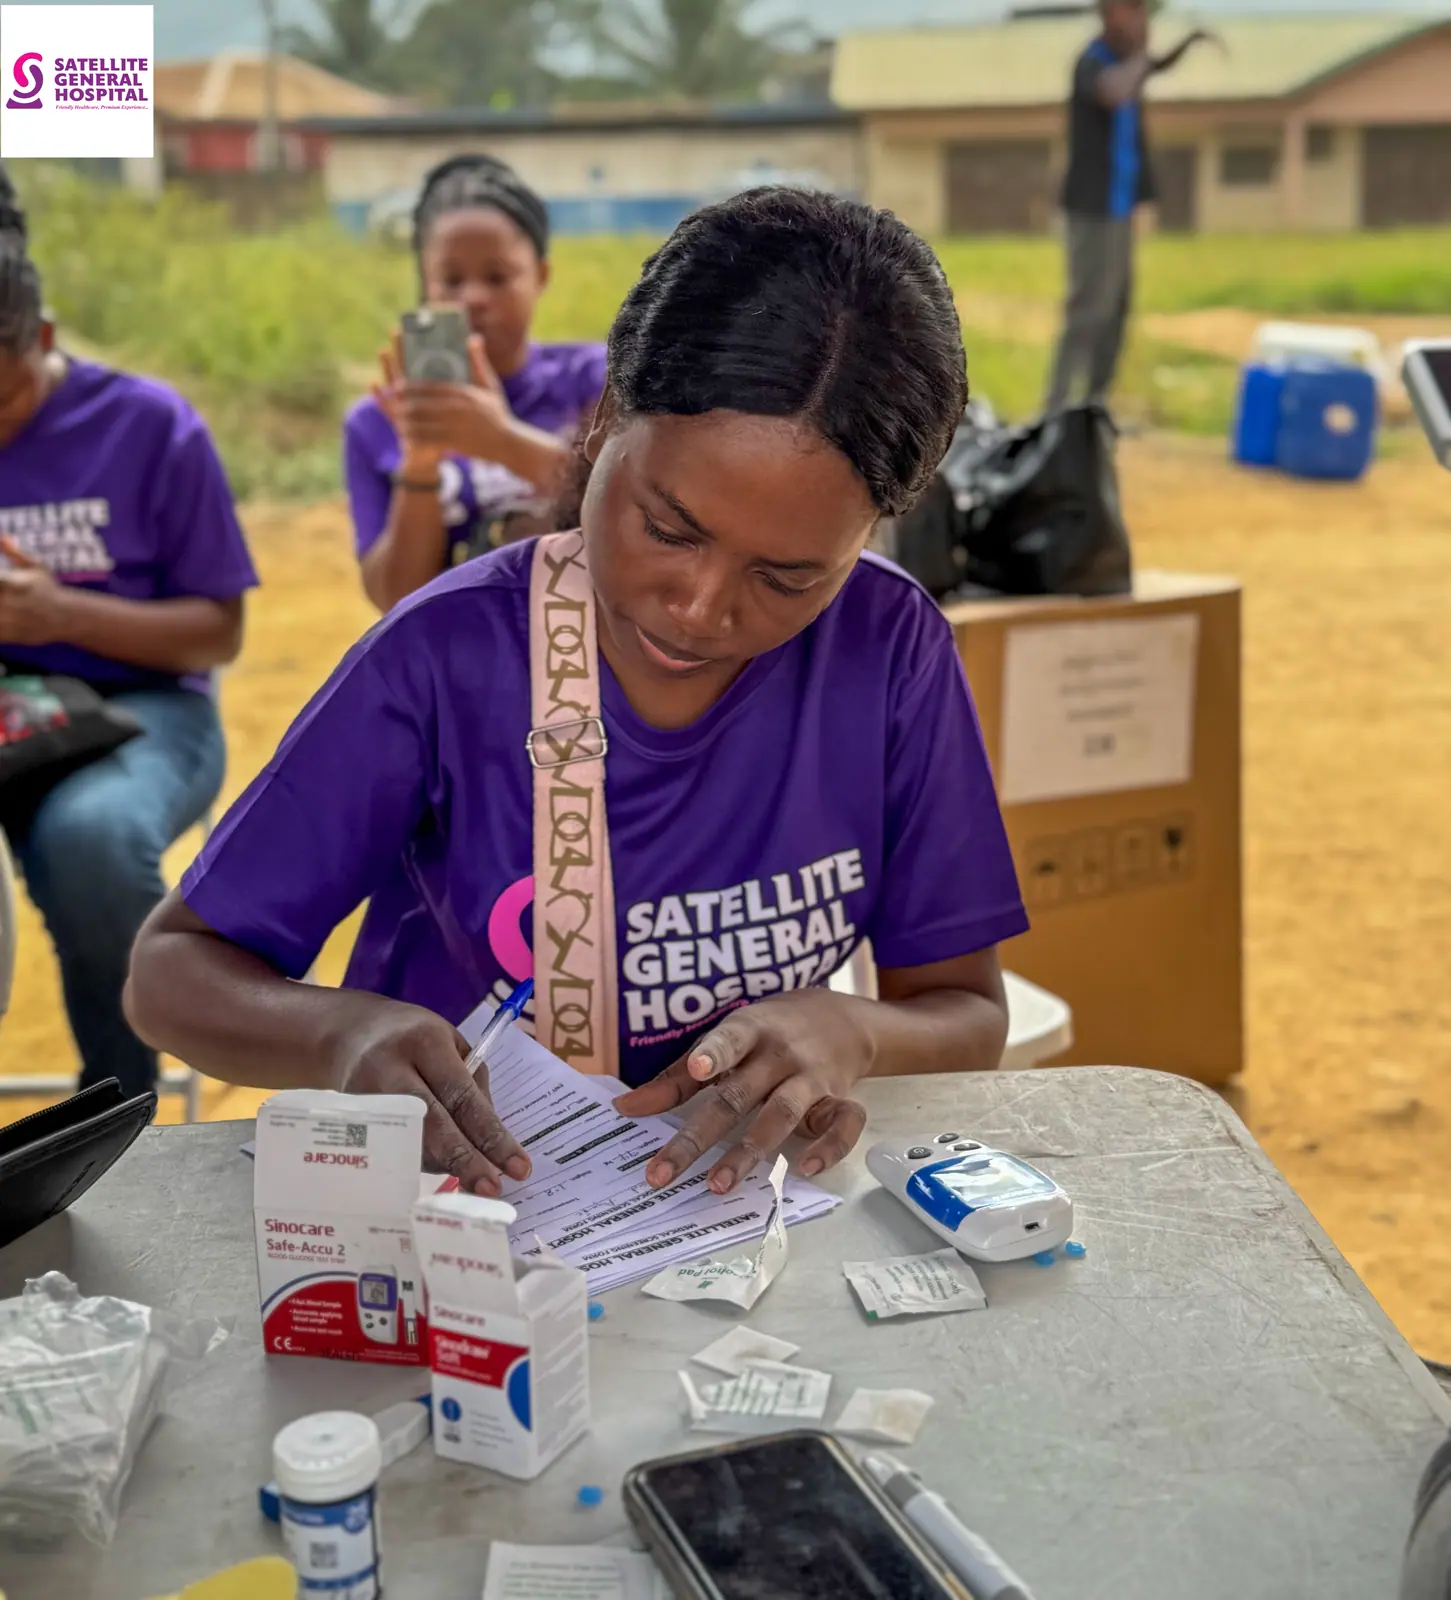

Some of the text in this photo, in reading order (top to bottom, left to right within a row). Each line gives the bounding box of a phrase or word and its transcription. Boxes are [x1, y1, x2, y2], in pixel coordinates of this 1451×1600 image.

[626, 848, 865, 943] SATELLITE
[622, 899, 856, 987] GENERAL
[629, 1026, 685, 1048] Friendly
[303, 1151, 368, 1169] Sinocare
[264, 1218, 335, 1236] Sinocare
[561, 1219, 589, 1233] FORM
[594, 1199, 656, 1229] GENERAL
[266, 1238, 346, 1256] Safe-Accu 2
[520, 1227, 595, 1258] HOSPIAL
[582, 1222, 699, 1262] MEDICAL SCREENING FORM
[613, 1211, 761, 1264] SATELLITE GENERAL
[677, 1268, 702, 1277] Pad
